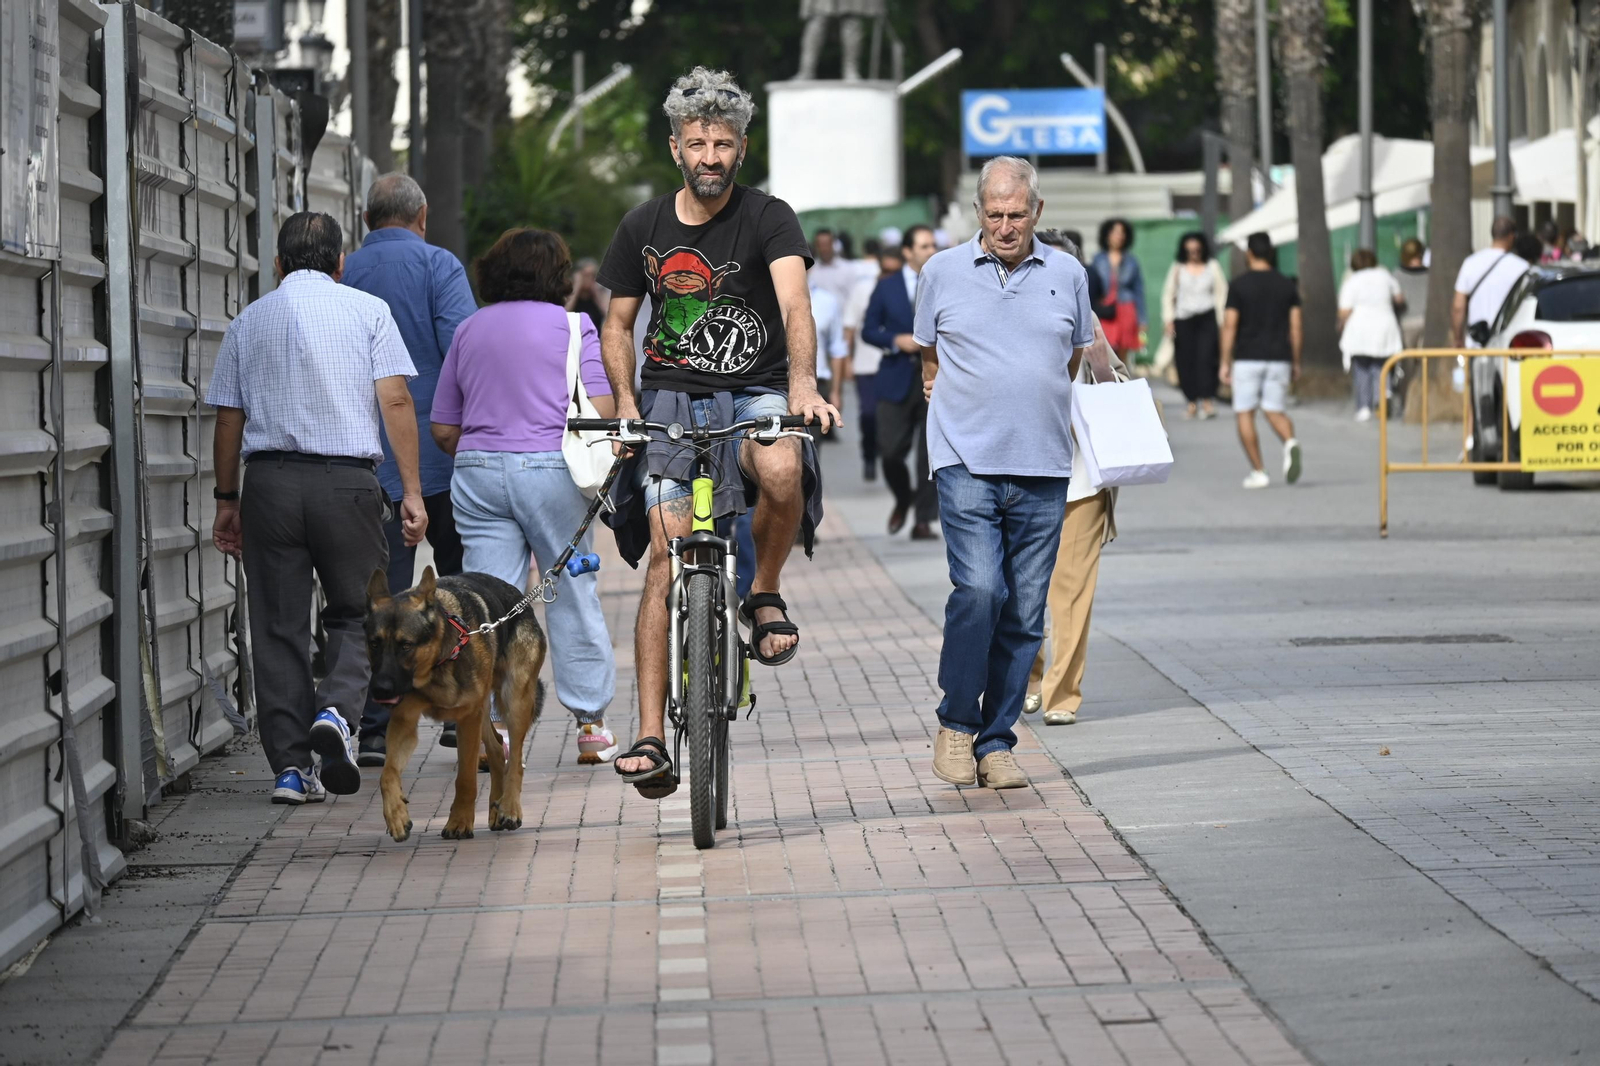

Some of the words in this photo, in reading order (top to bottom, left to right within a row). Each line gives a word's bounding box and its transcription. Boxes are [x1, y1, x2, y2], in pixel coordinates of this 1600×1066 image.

[966, 94, 1102, 149] GLESA
[1533, 424, 1588, 435] ACCESO
[1556, 442, 1584, 452] POR
[1527, 457, 1583, 465] DISCULPEN
